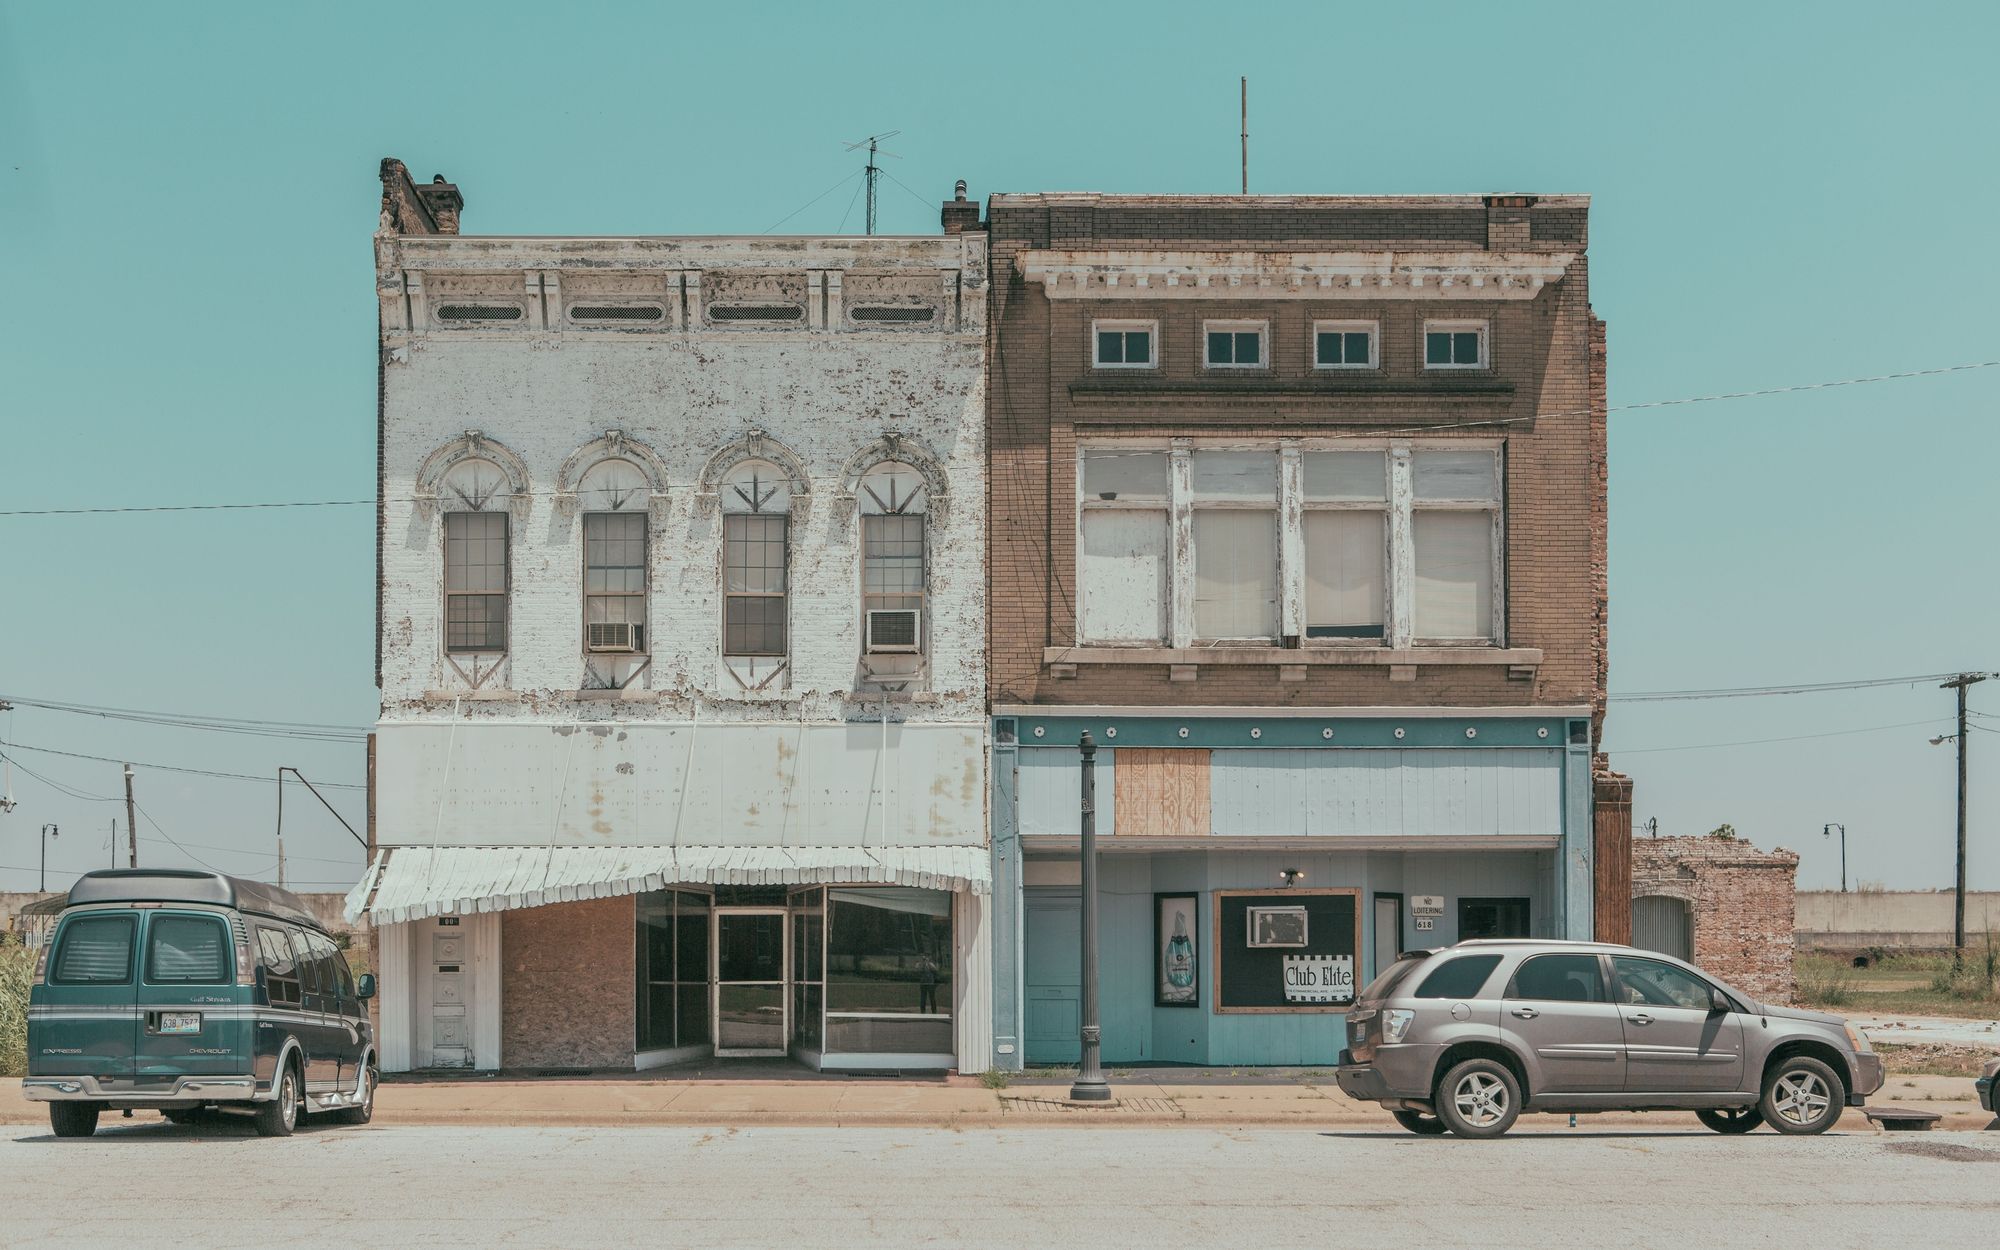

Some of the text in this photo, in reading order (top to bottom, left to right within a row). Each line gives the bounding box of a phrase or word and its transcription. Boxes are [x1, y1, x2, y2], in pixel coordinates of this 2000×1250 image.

[1417, 921, 1432, 929] 618
[1285, 964, 1351, 986] Club Elite
